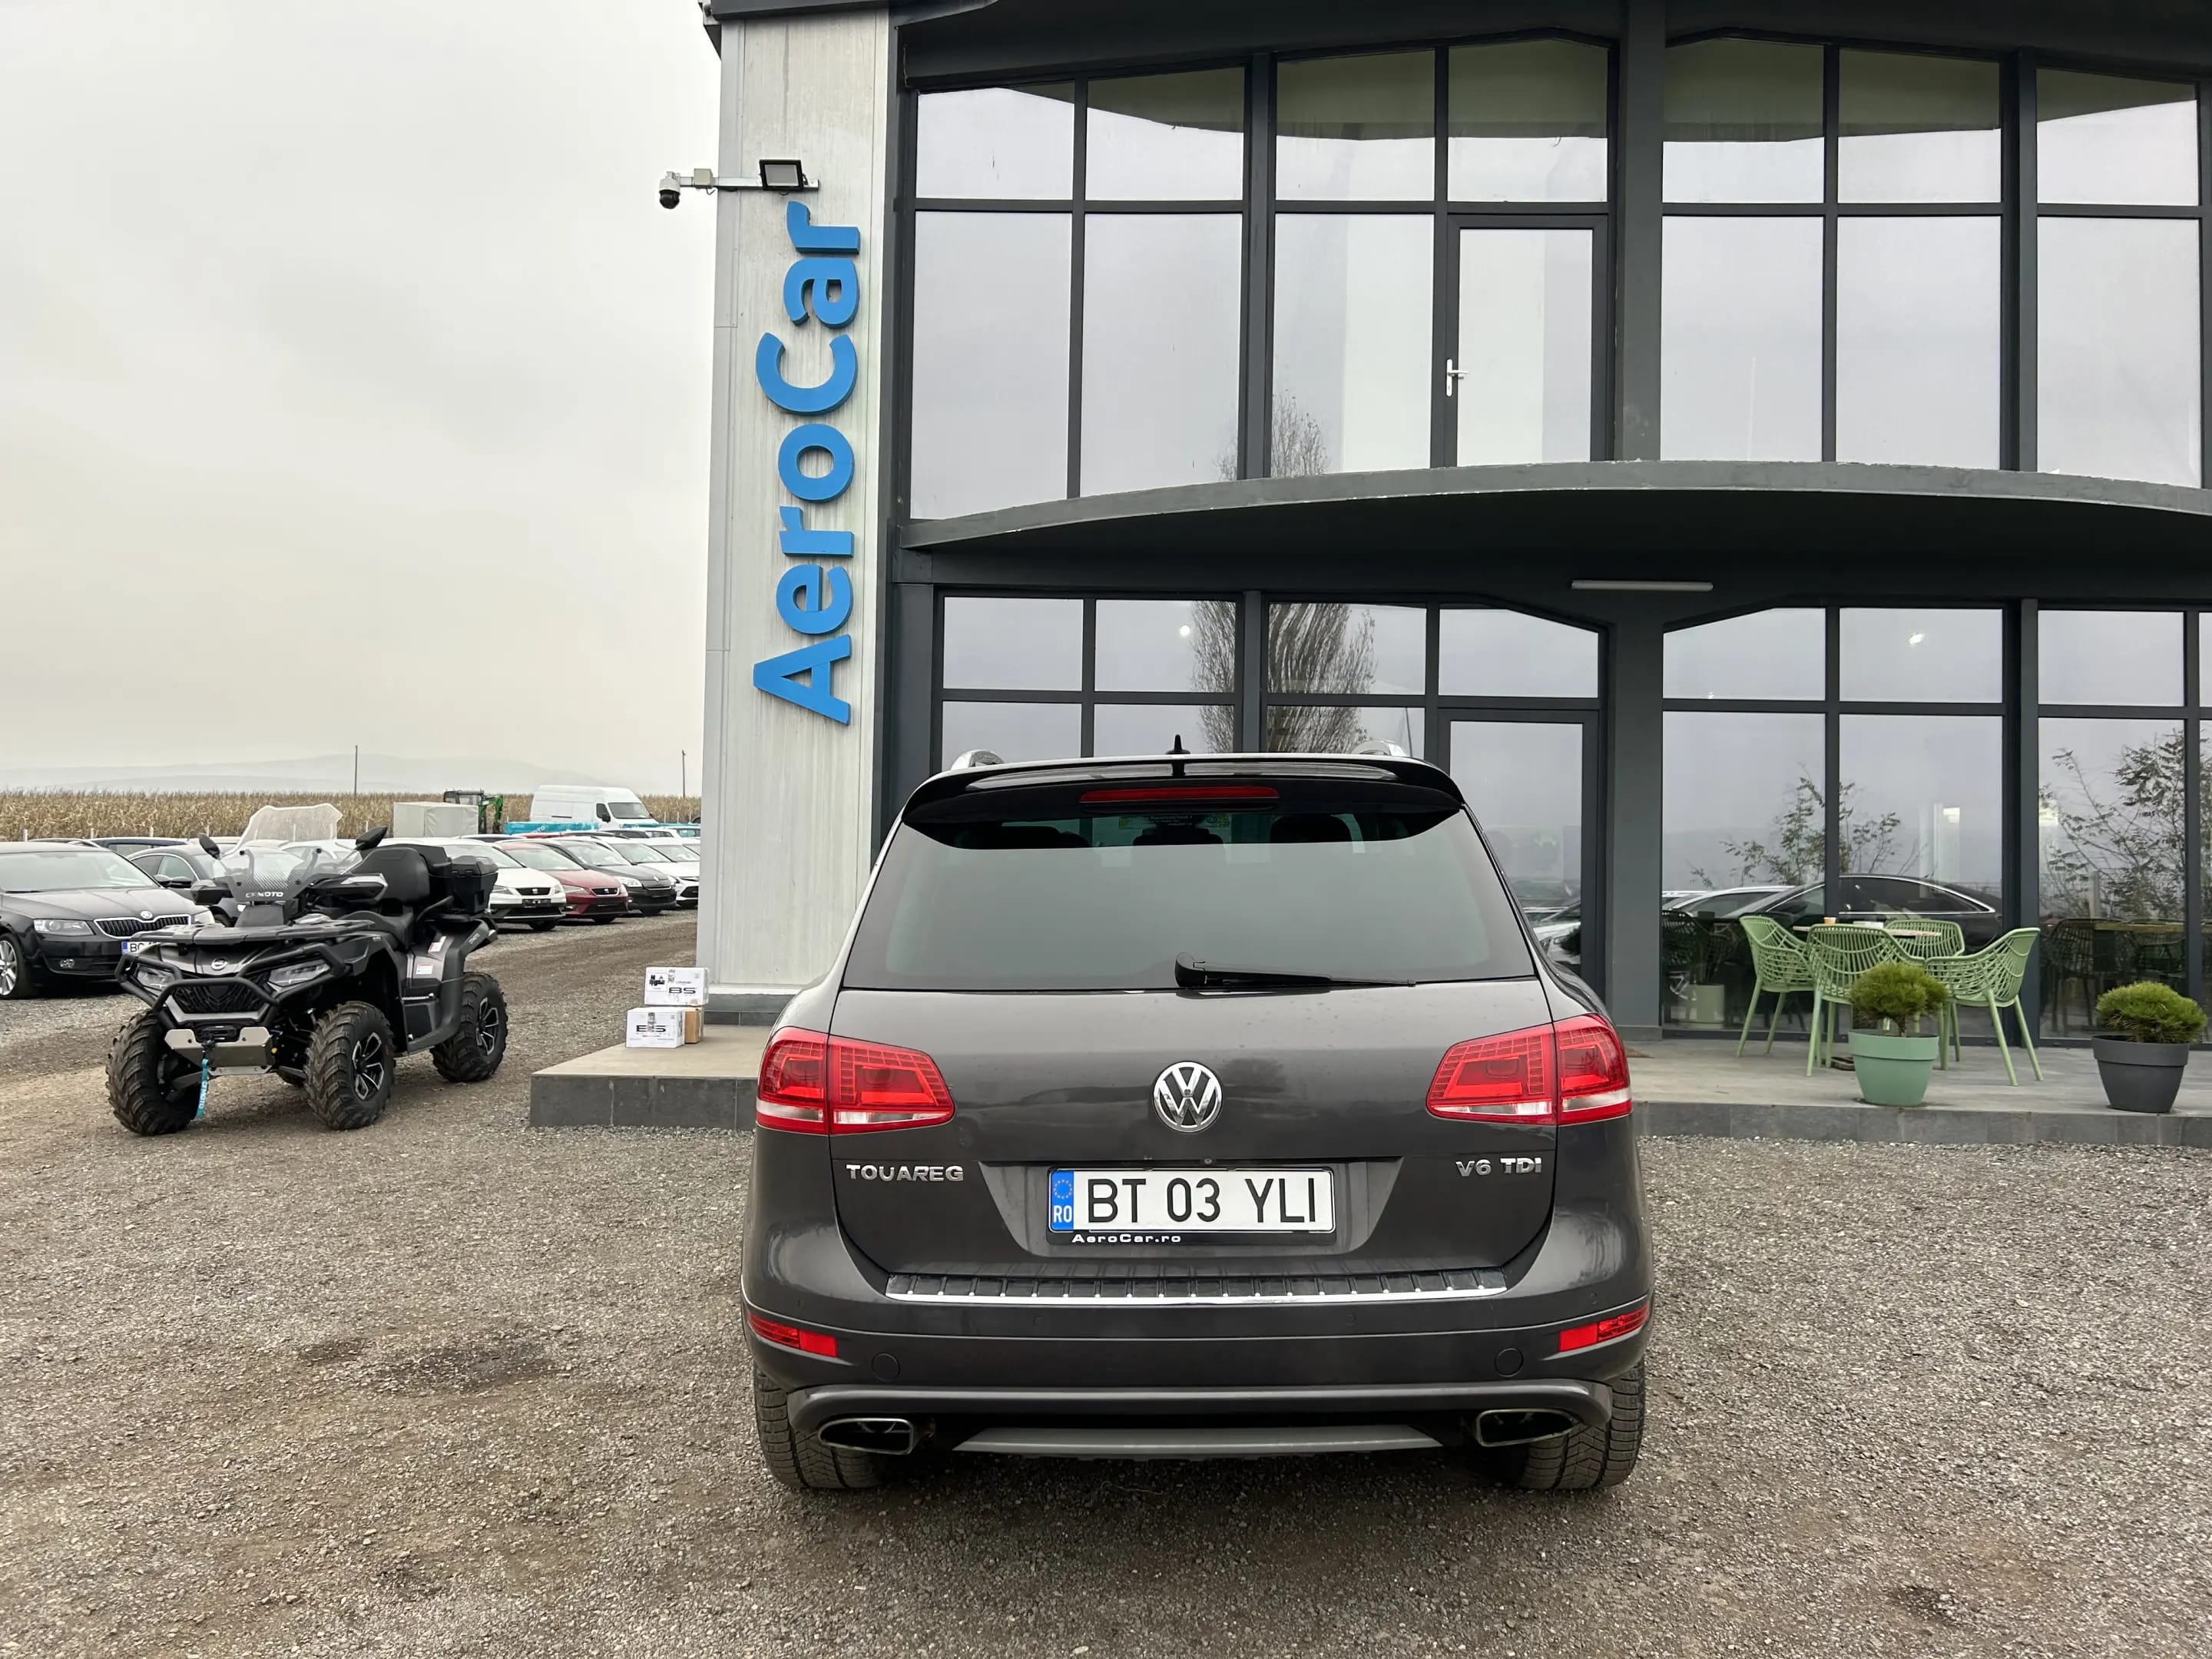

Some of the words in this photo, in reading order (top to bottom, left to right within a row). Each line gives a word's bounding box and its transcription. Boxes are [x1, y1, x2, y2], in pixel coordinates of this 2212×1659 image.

[753, 200, 859, 726] AeroCar
[846, 1164, 964, 1181] TOUAREG
[1455, 1159, 1492, 1177] V6
[1500, 1157, 1541, 1174] TDI
[1088, 1177, 1147, 1224] BT
[1166, 1177, 1221, 1223] 03
[1245, 1177, 1316, 1224] YLI
[1053, 1205, 1072, 1224] RO
[1071, 1233, 1181, 1243] AeroCar.ro
